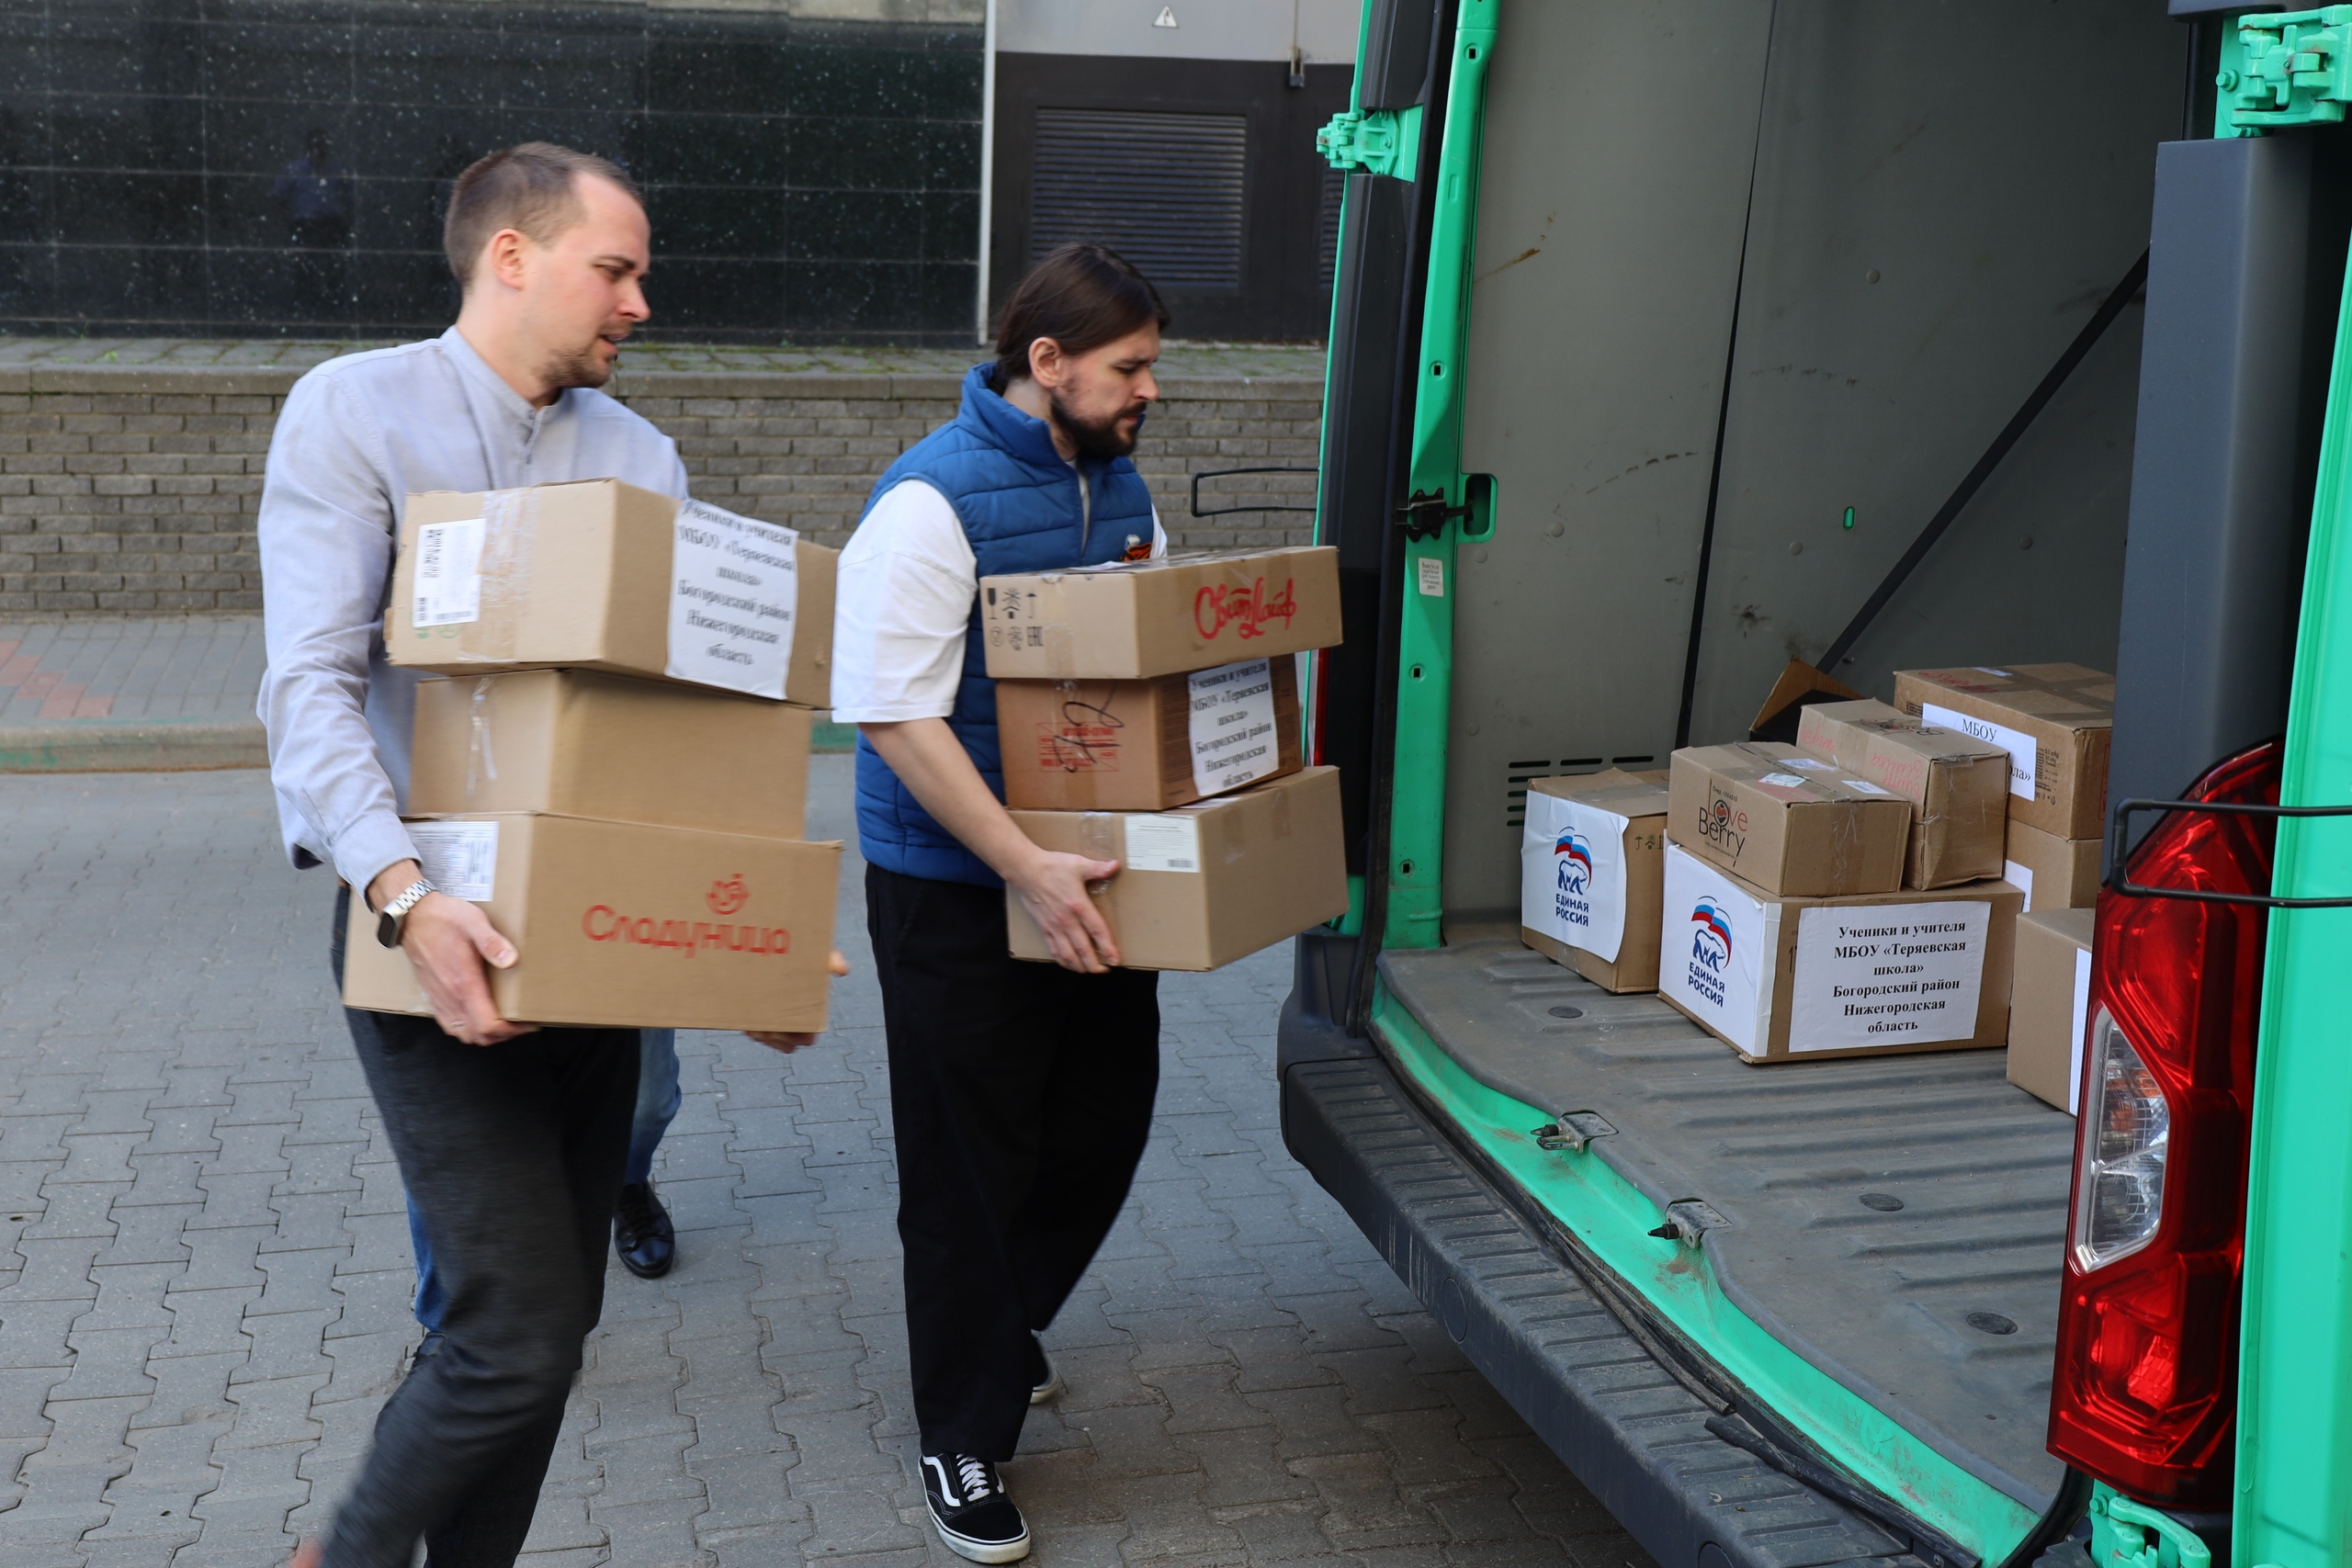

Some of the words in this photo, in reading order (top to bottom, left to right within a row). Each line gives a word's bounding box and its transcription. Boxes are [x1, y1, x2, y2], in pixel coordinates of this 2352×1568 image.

[1962, 718, 1997, 741] МБОУ
[1708, 779, 1747, 831] Love
[1699, 807, 1746, 867] Berry
[1555, 893, 1589, 913] ЕДИНАЯ
[1555, 906, 1589, 927] РОССИЯ
[1838, 926, 1897, 938] Ученики
[1901, 926, 1909, 935] и
[1913, 922, 1966, 937] учителя
[1834, 944, 1880, 959] МБОУ
[1883, 942, 1966, 957] «Теряевская
[1689, 961, 1724, 993] ЕДИНАЯ
[1873, 964, 1924, 976] школа»
[1688, 975, 1724, 1008] РОССИЯ
[1833, 981, 1917, 998] Богородский
[1921, 978, 1960, 994] район
[1844, 1000, 1946, 1016] Нижегородская
[1868, 1021, 1918, 1033] область
